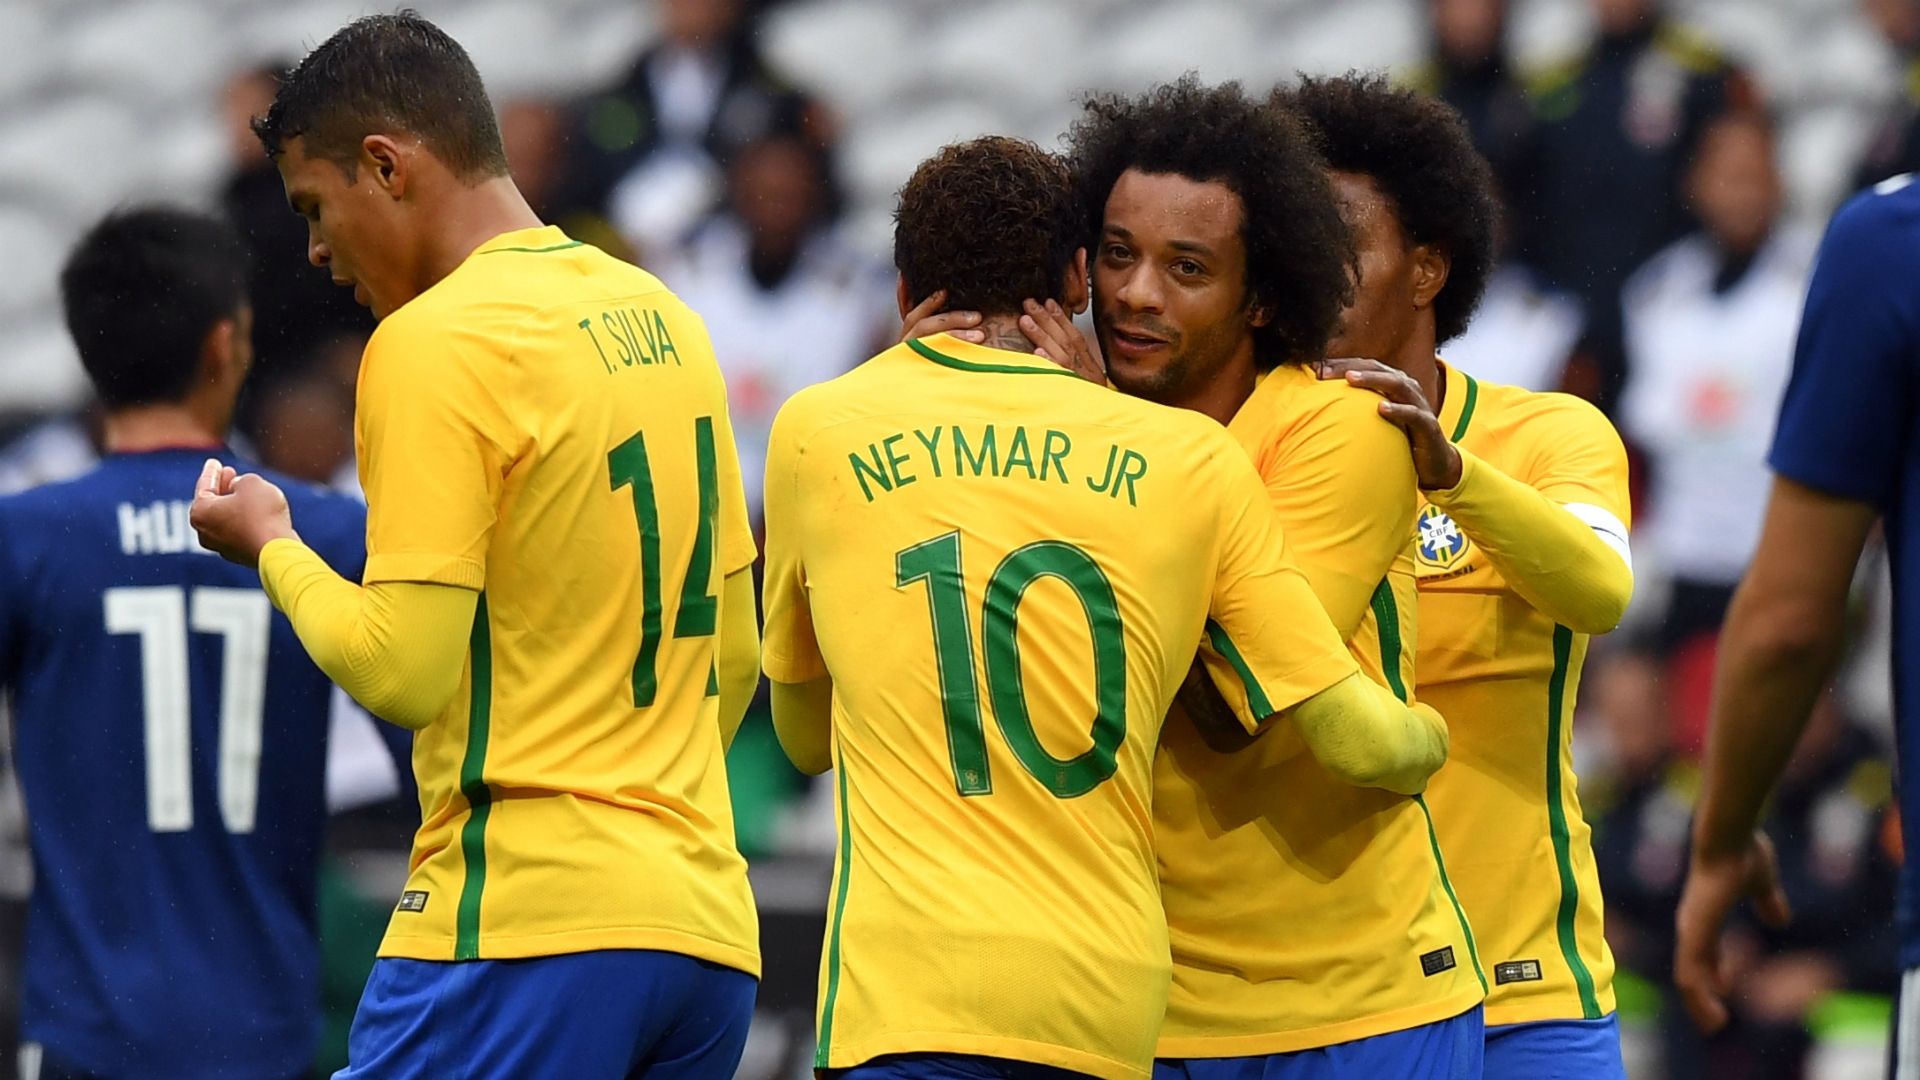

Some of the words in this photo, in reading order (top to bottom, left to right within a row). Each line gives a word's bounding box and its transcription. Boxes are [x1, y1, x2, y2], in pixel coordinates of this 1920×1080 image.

[602, 308, 681, 366] SILVA
[848, 424, 1070, 502] NEYMAR
[1086, 444, 1148, 507] JR
[607, 416, 719, 708] 14
[1429, 525, 1449, 538] CBF
[895, 528, 1127, 799] 10
